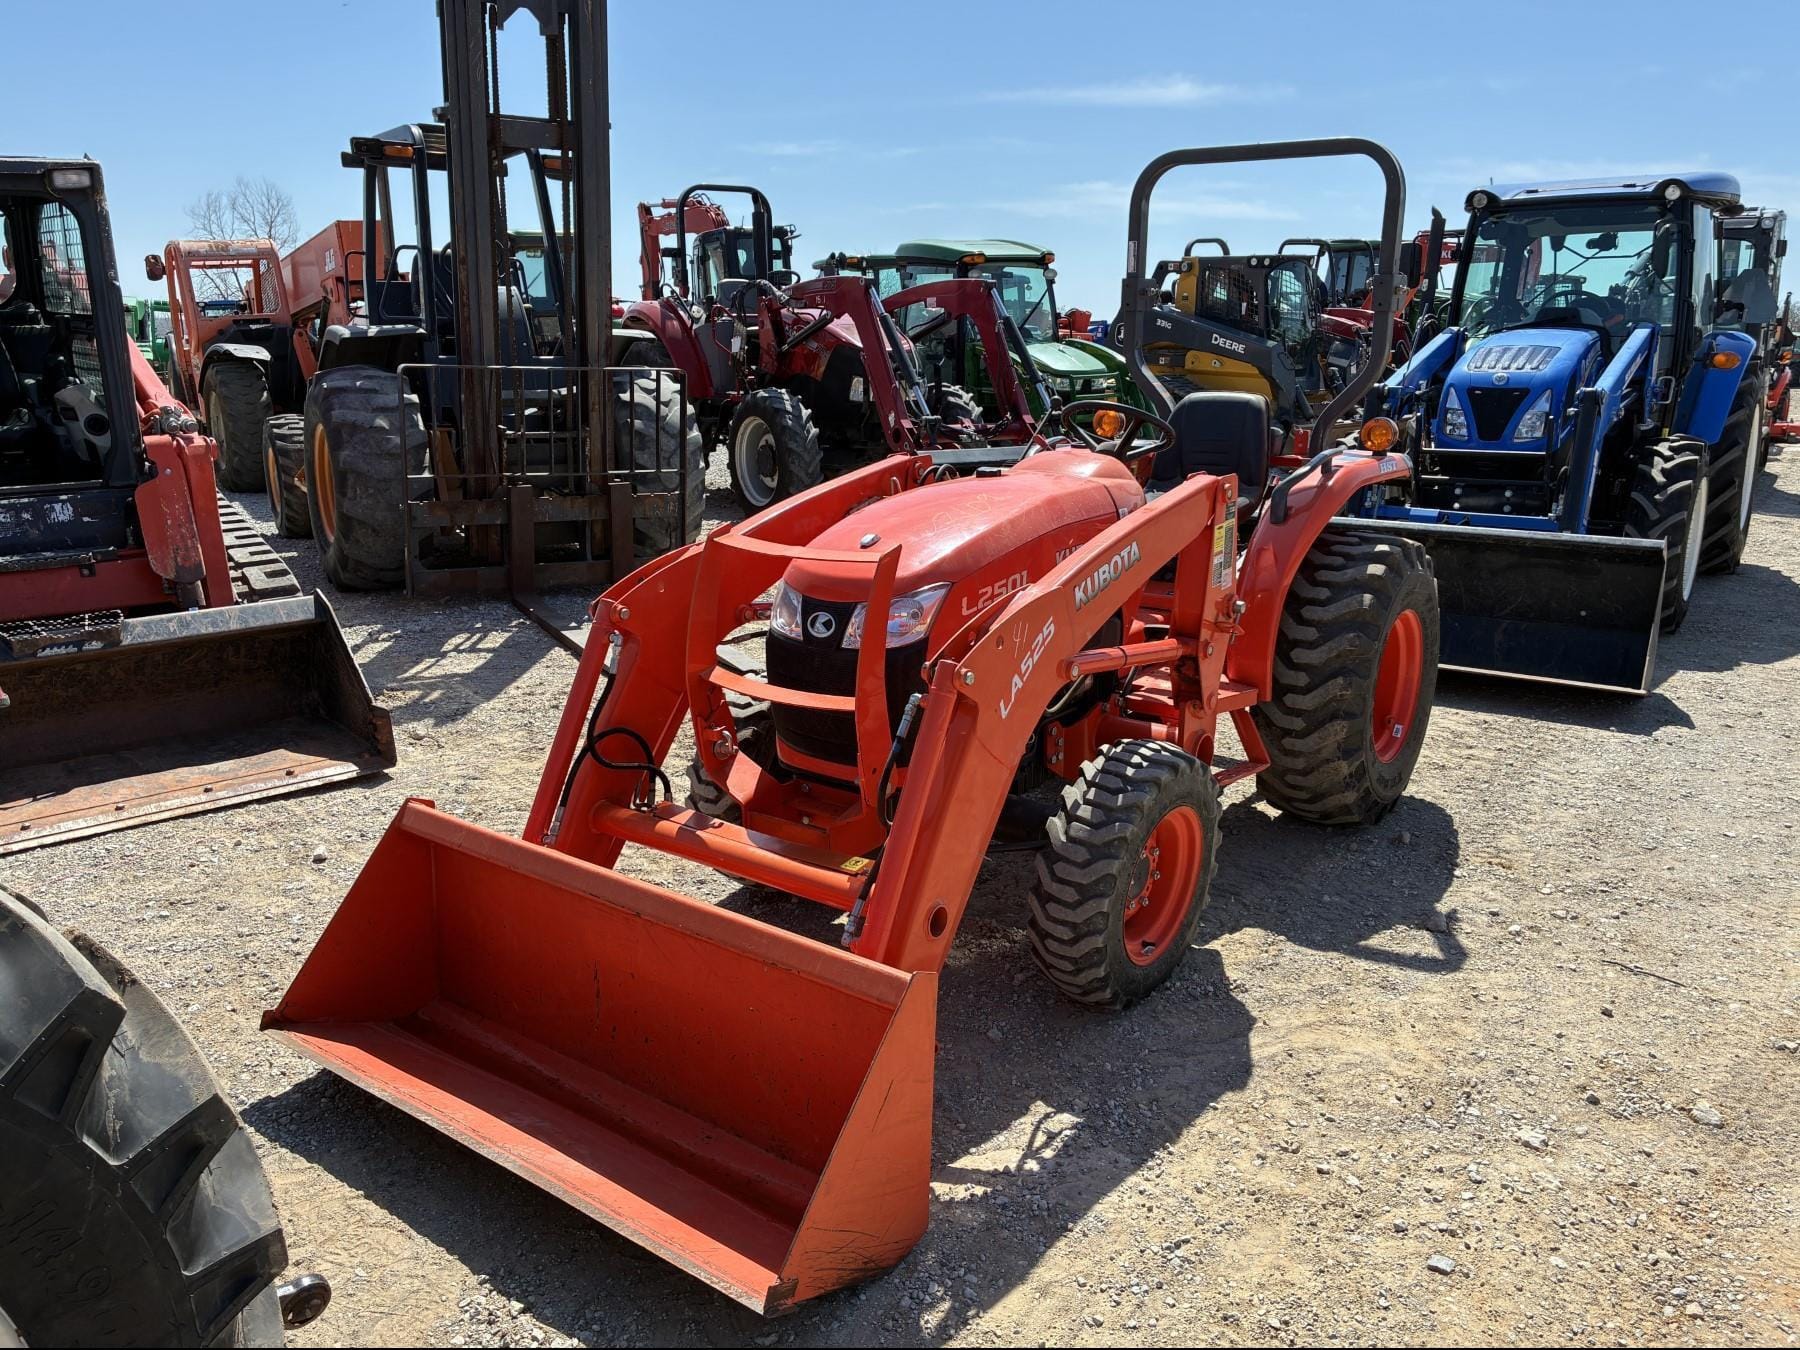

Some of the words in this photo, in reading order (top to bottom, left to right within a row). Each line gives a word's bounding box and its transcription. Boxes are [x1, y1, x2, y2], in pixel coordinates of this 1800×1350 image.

[1211, 333, 1246, 354] DEERE
[961, 569, 1029, 616] L2501
[1074, 541, 1141, 611] KUBOTA
[1000, 615, 1056, 720] LA525
